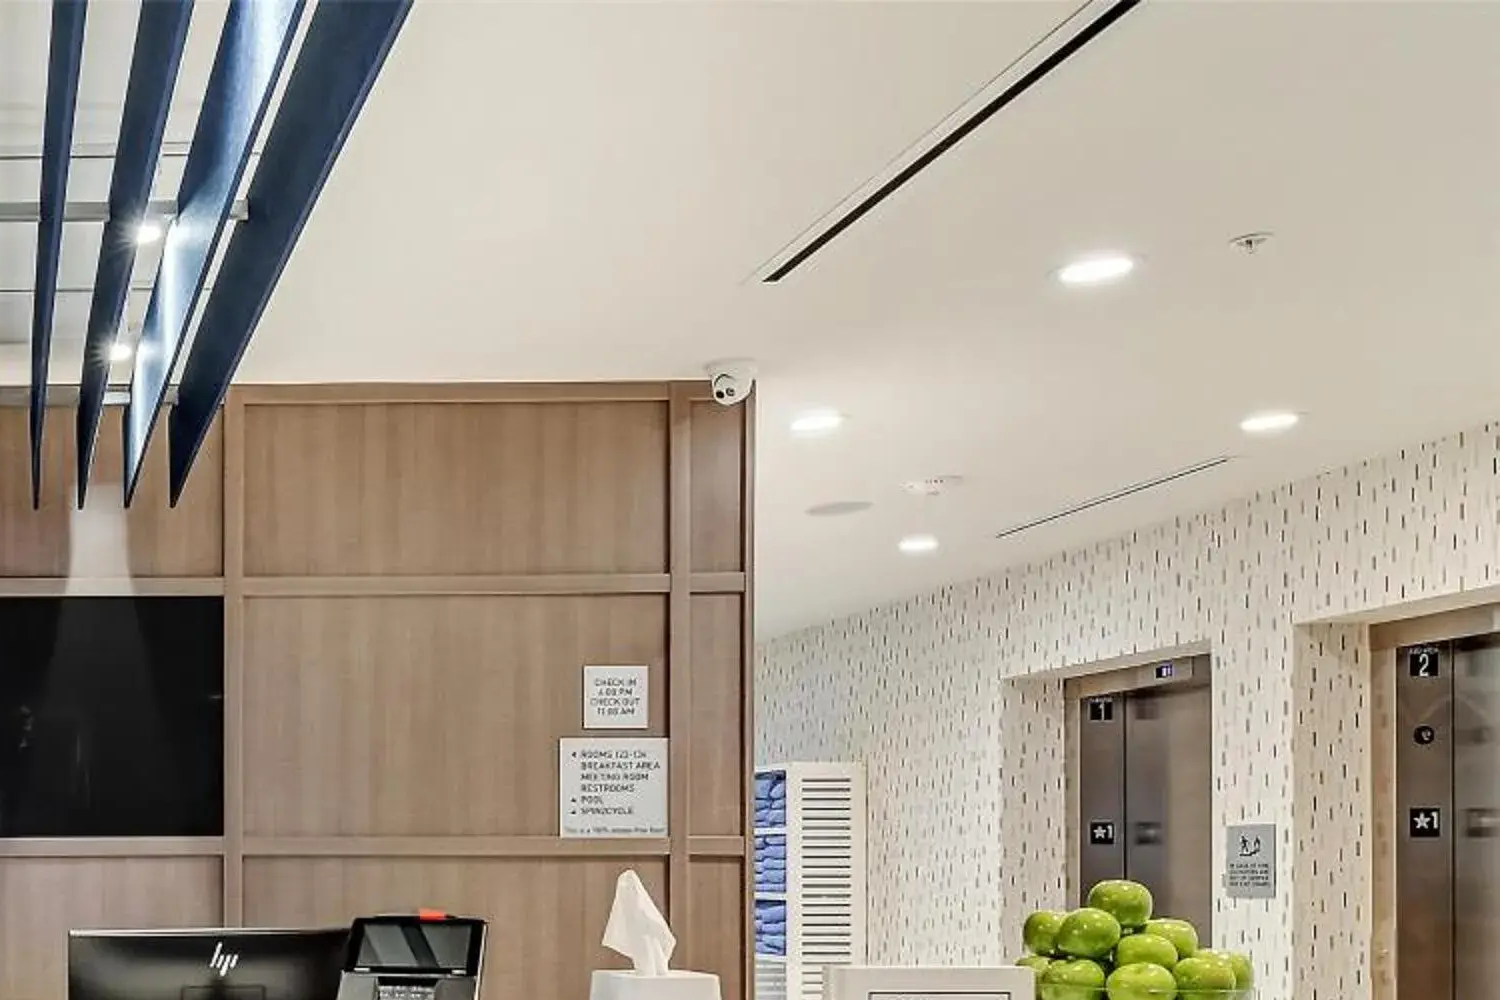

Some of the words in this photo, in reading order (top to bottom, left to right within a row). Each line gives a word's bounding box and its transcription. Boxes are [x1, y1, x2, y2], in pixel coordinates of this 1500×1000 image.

[1419, 653, 1429, 676] 2
[581, 761, 634, 770] BREAKFAST
[635, 761, 661, 770] AREA
[581, 784, 635, 792] RESTROOMS
[209, 941, 239, 977] hp
